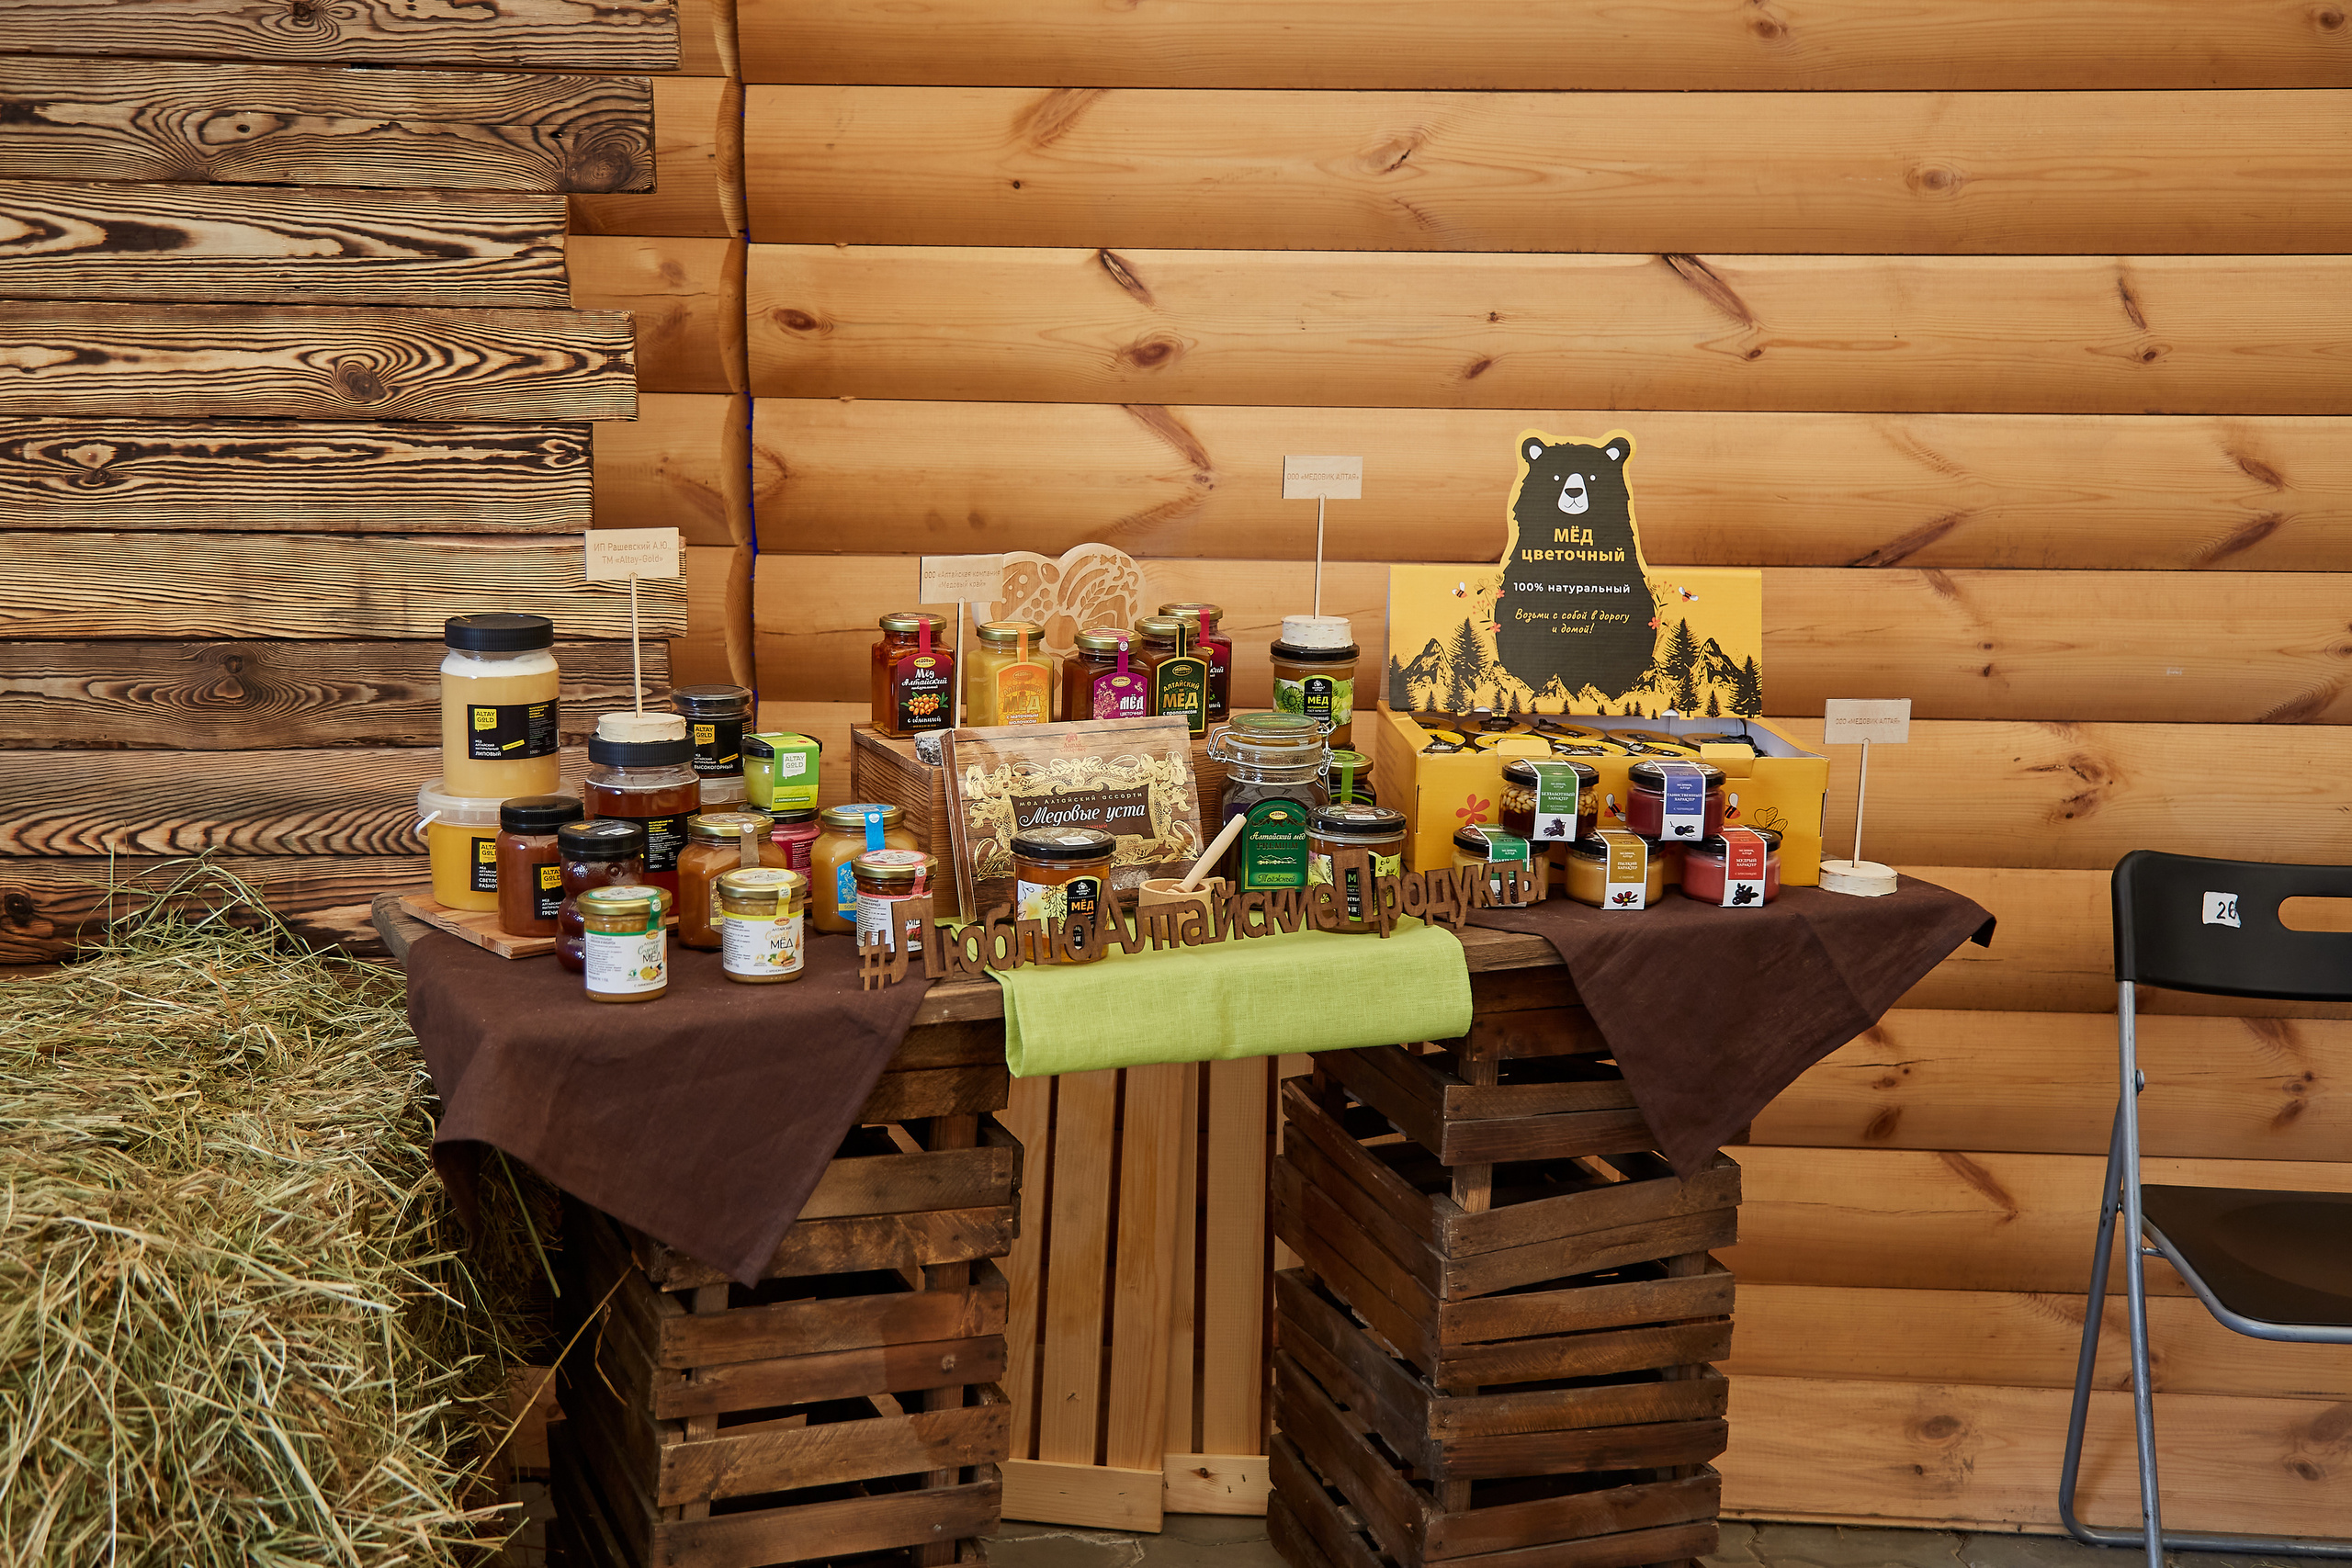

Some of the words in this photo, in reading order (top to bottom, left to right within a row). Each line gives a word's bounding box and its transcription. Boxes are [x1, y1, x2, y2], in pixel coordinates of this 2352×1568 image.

[1301, 473, 1334, 481] «МЕДОВИК
[1554, 525, 1594, 546] МЁД
[594, 543, 605, 551] ИП
[607, 541, 650, 551] Рашевский
[602, 556, 614, 564] ТМ
[615, 554, 663, 565] «Altay-Gold»
[1521, 547, 1625, 563] цветочный
[969, 580, 986, 588] край»
[1513, 582, 1544, 592] 100%
[1548, 584, 1631, 594] натуральный
[1515, 608, 1550, 623] Возьми
[1553, 612, 1559, 620] с
[1562, 610, 1588, 620] собой
[1590, 610, 1598, 620] в
[1599, 611, 1630, 624] дорогу
[1561, 623, 1595, 634] домой!
[915, 668, 935, 680] Мёд
[901, 677, 948, 687] Алтайский
[1163, 679, 1201, 693] АЛТАЙСКИЙ
[1003, 691, 1041, 714] МЁД
[1120, 694, 1144, 711] МЁД
[1162, 688, 1199, 710] МЁД
[1307, 694, 1329, 705] МЁД
[785, 754, 805, 762] ALTAY
[1045, 795, 1096, 805] Алтайский
[1102, 792, 1143, 800] ассорти
[1019, 804, 1101, 827] Медовые
[1105, 804, 1146, 822] уста
[1250, 831, 1291, 840] Алтайский
[1293, 832, 1306, 840] мёд
[1071, 899, 1094, 911] МЁД
[2216, 900, 2237, 919] 26
[770, 936, 793, 950] МЁД
[642, 951, 662, 964] МЁД
